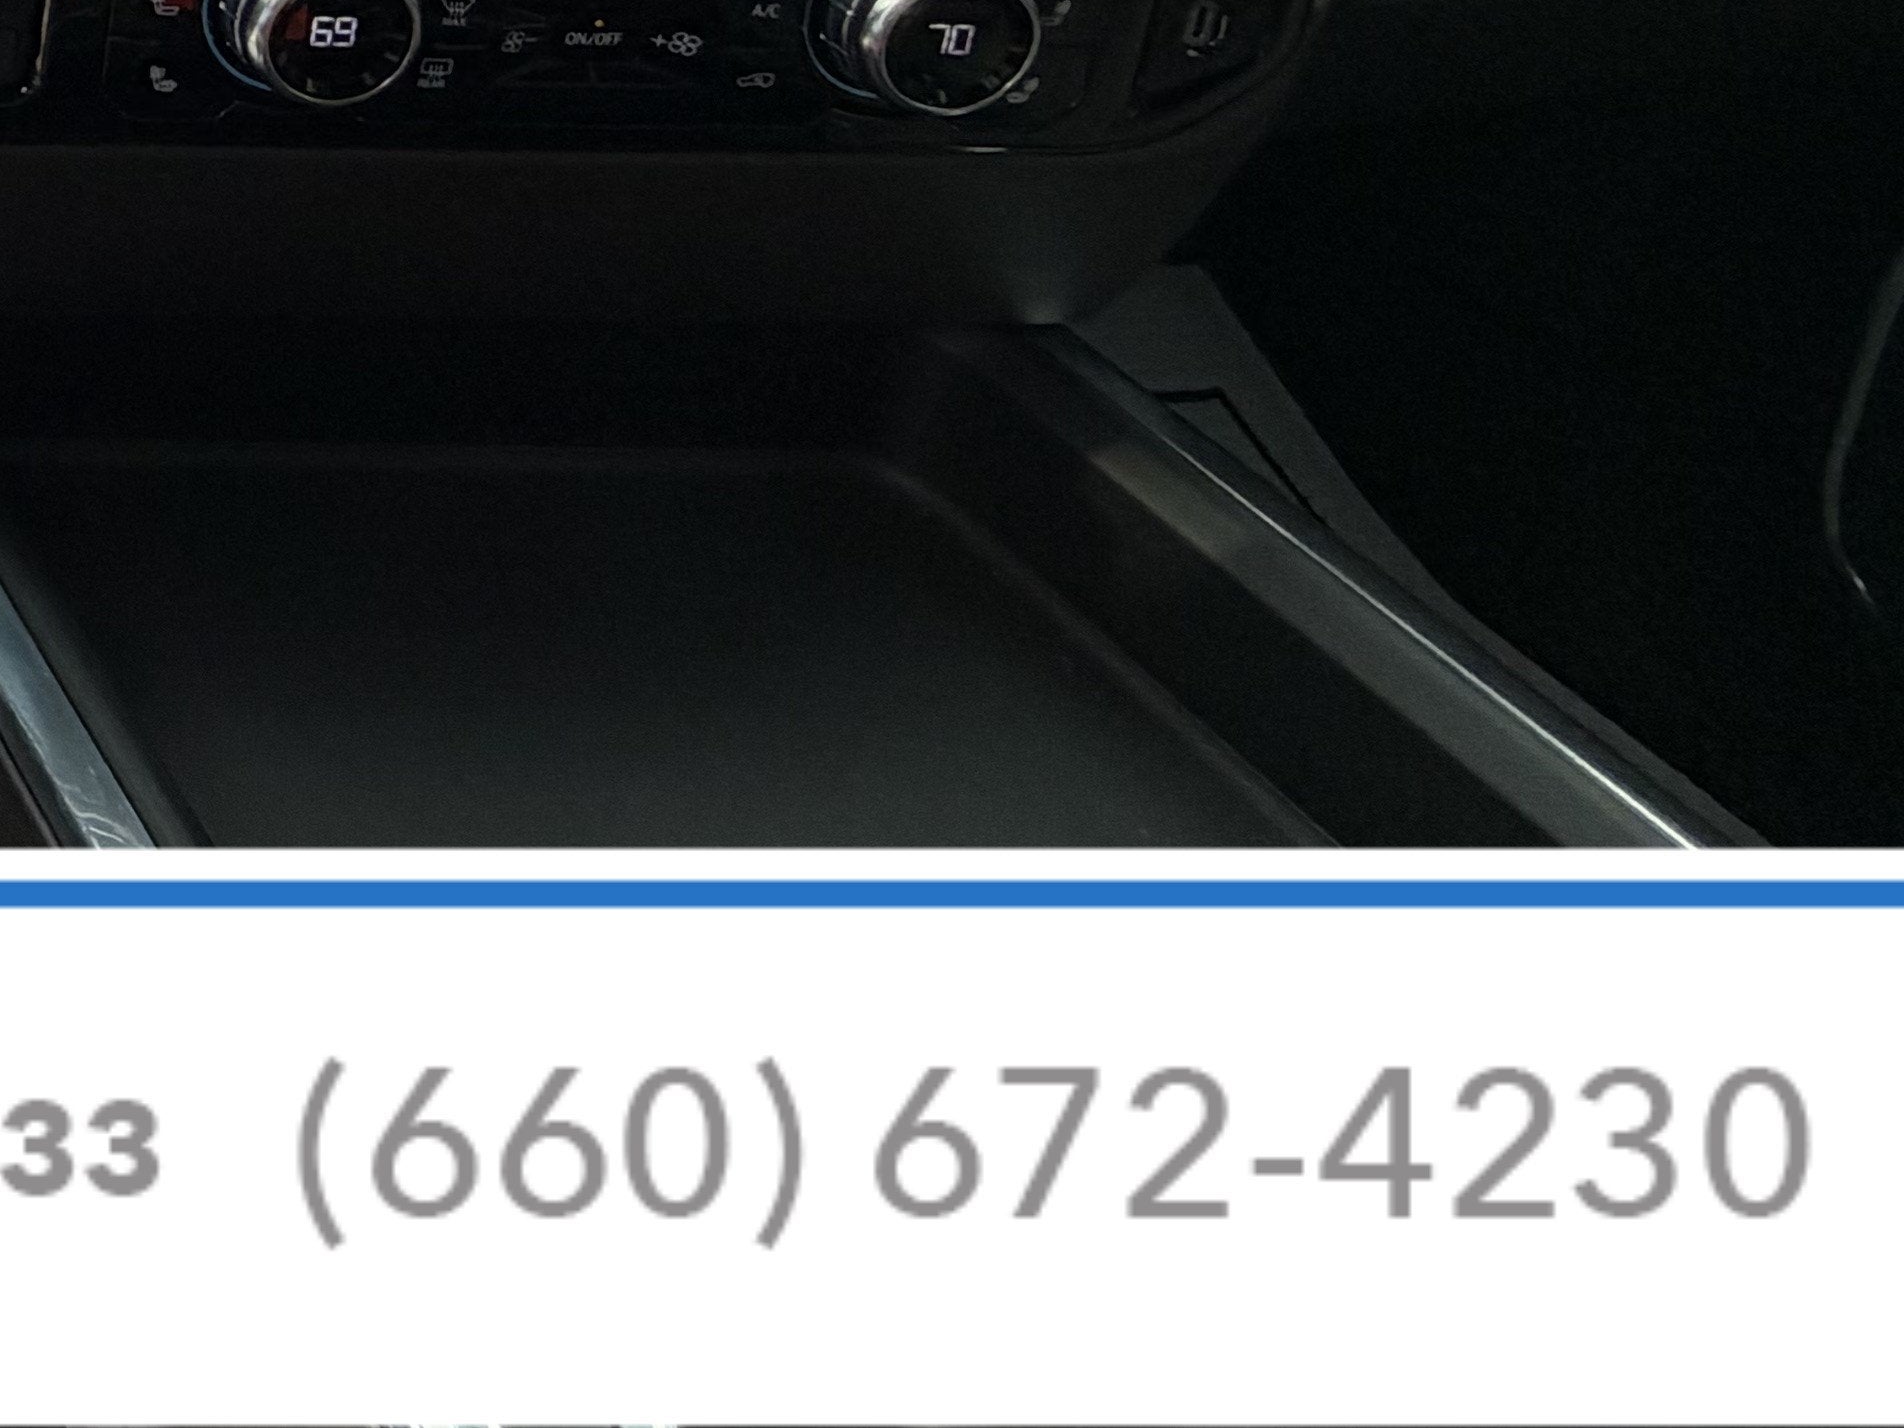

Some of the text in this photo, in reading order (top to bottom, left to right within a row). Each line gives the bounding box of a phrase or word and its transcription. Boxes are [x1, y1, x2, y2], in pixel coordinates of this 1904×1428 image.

[750, 2, 783, 20] A/C
[308, 15, 360, 49] 69
[563, 30, 624, 47] ON/OFF
[927, 23, 977, 57] 70
